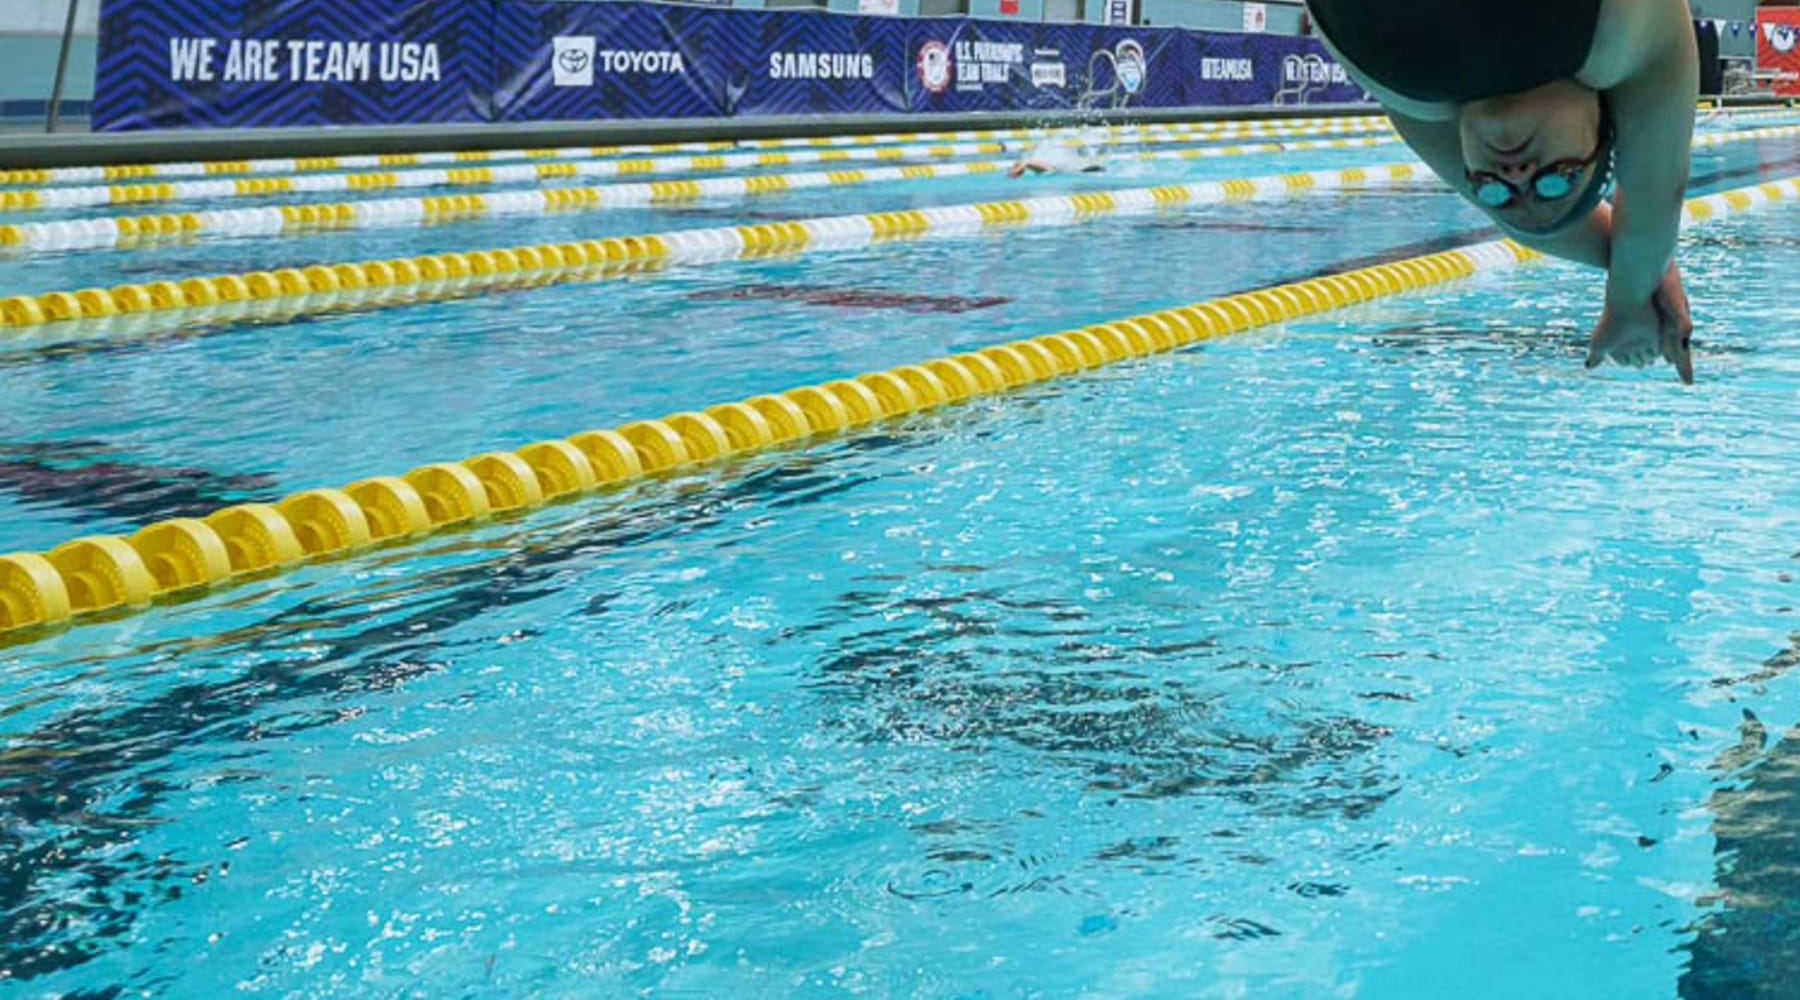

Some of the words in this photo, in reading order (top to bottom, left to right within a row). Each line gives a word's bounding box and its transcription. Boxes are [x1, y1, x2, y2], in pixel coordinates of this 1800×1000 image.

[170, 38, 217, 81] WE
[223, 39, 280, 81] ARE
[287, 41, 370, 82] TEAM
[379, 42, 441, 82] USA
[600, 51, 685, 73] TOYOTA
[770, 51, 873, 79] SAMSUNG
